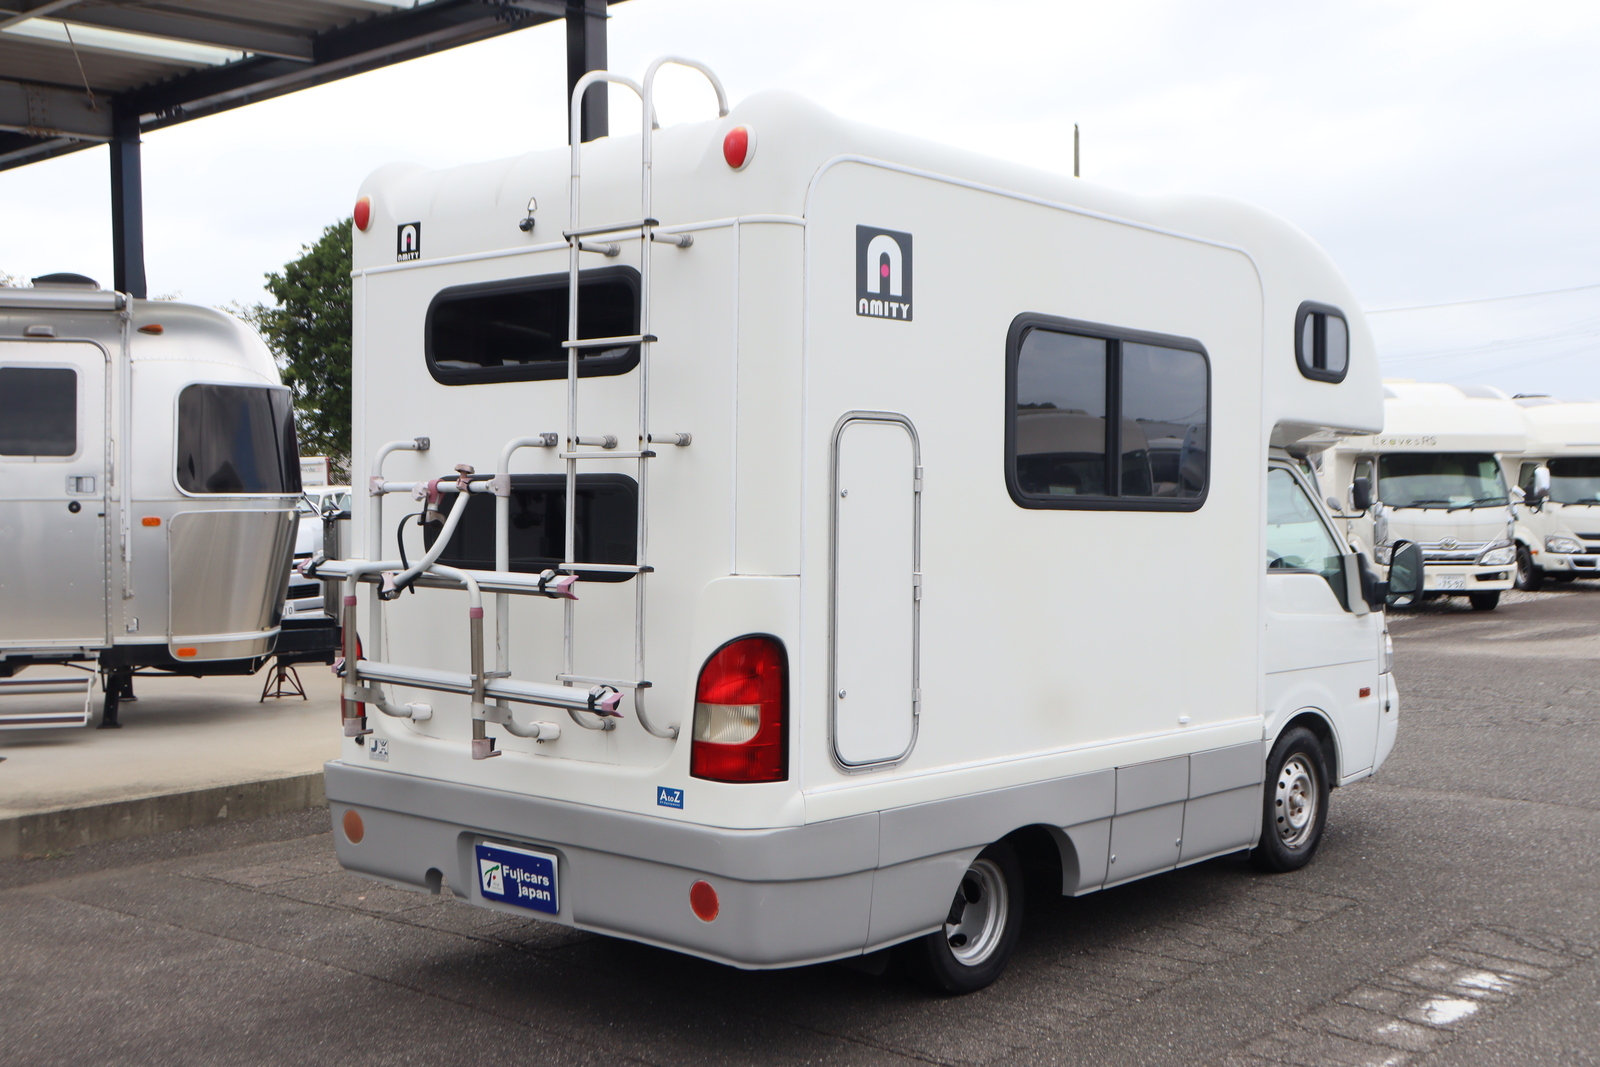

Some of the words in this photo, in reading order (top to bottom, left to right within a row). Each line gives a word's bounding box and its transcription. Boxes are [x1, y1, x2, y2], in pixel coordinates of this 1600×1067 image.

[858, 298, 910, 319] AMITY
[502, 865, 550, 887] Fujicars
[517, 882, 551, 902] japan
